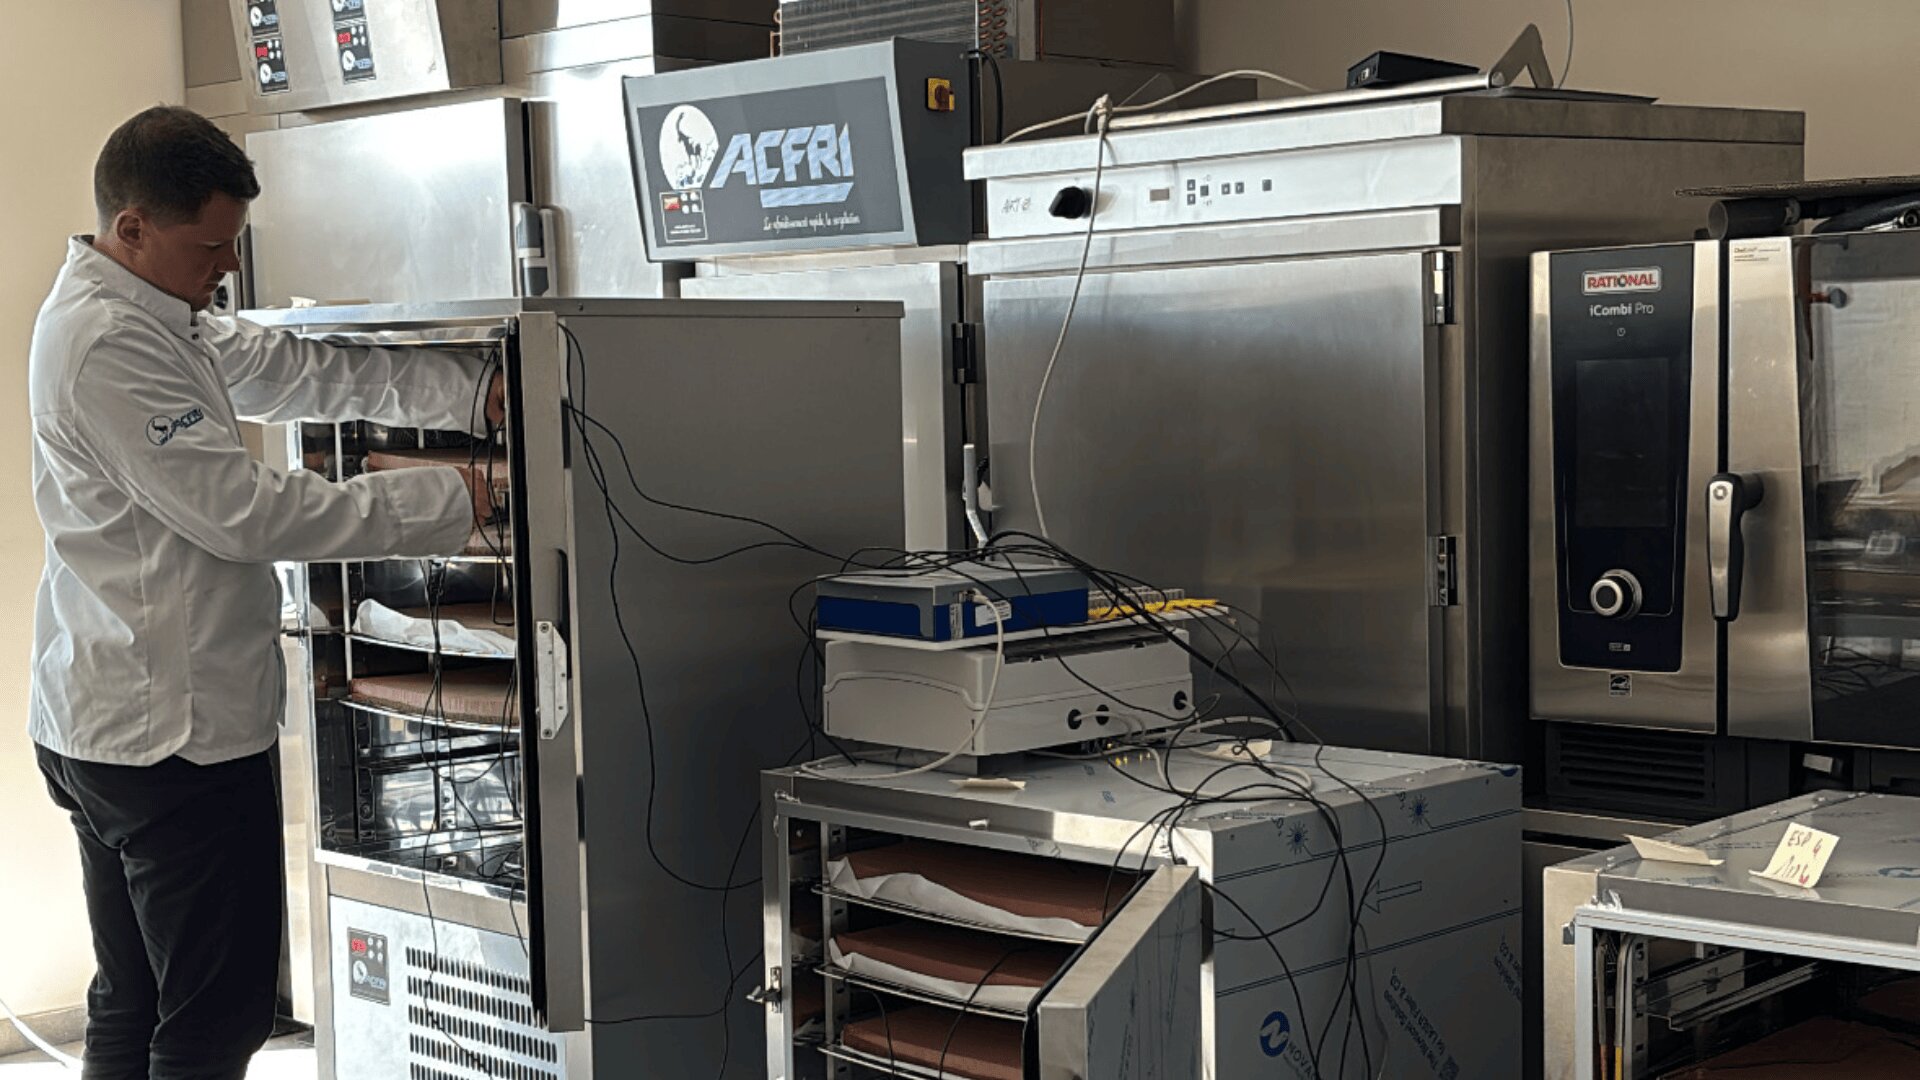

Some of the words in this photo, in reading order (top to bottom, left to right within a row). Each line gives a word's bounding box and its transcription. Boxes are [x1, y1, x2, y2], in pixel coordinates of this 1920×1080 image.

[709, 122, 854, 189] ACFRI
[1587, 273, 1657, 289] RATIONAL
[1589, 303, 1633, 317] iCombi
[1634, 301, 1655, 315] Pro
[1787, 830, 1812, 847] ESP
